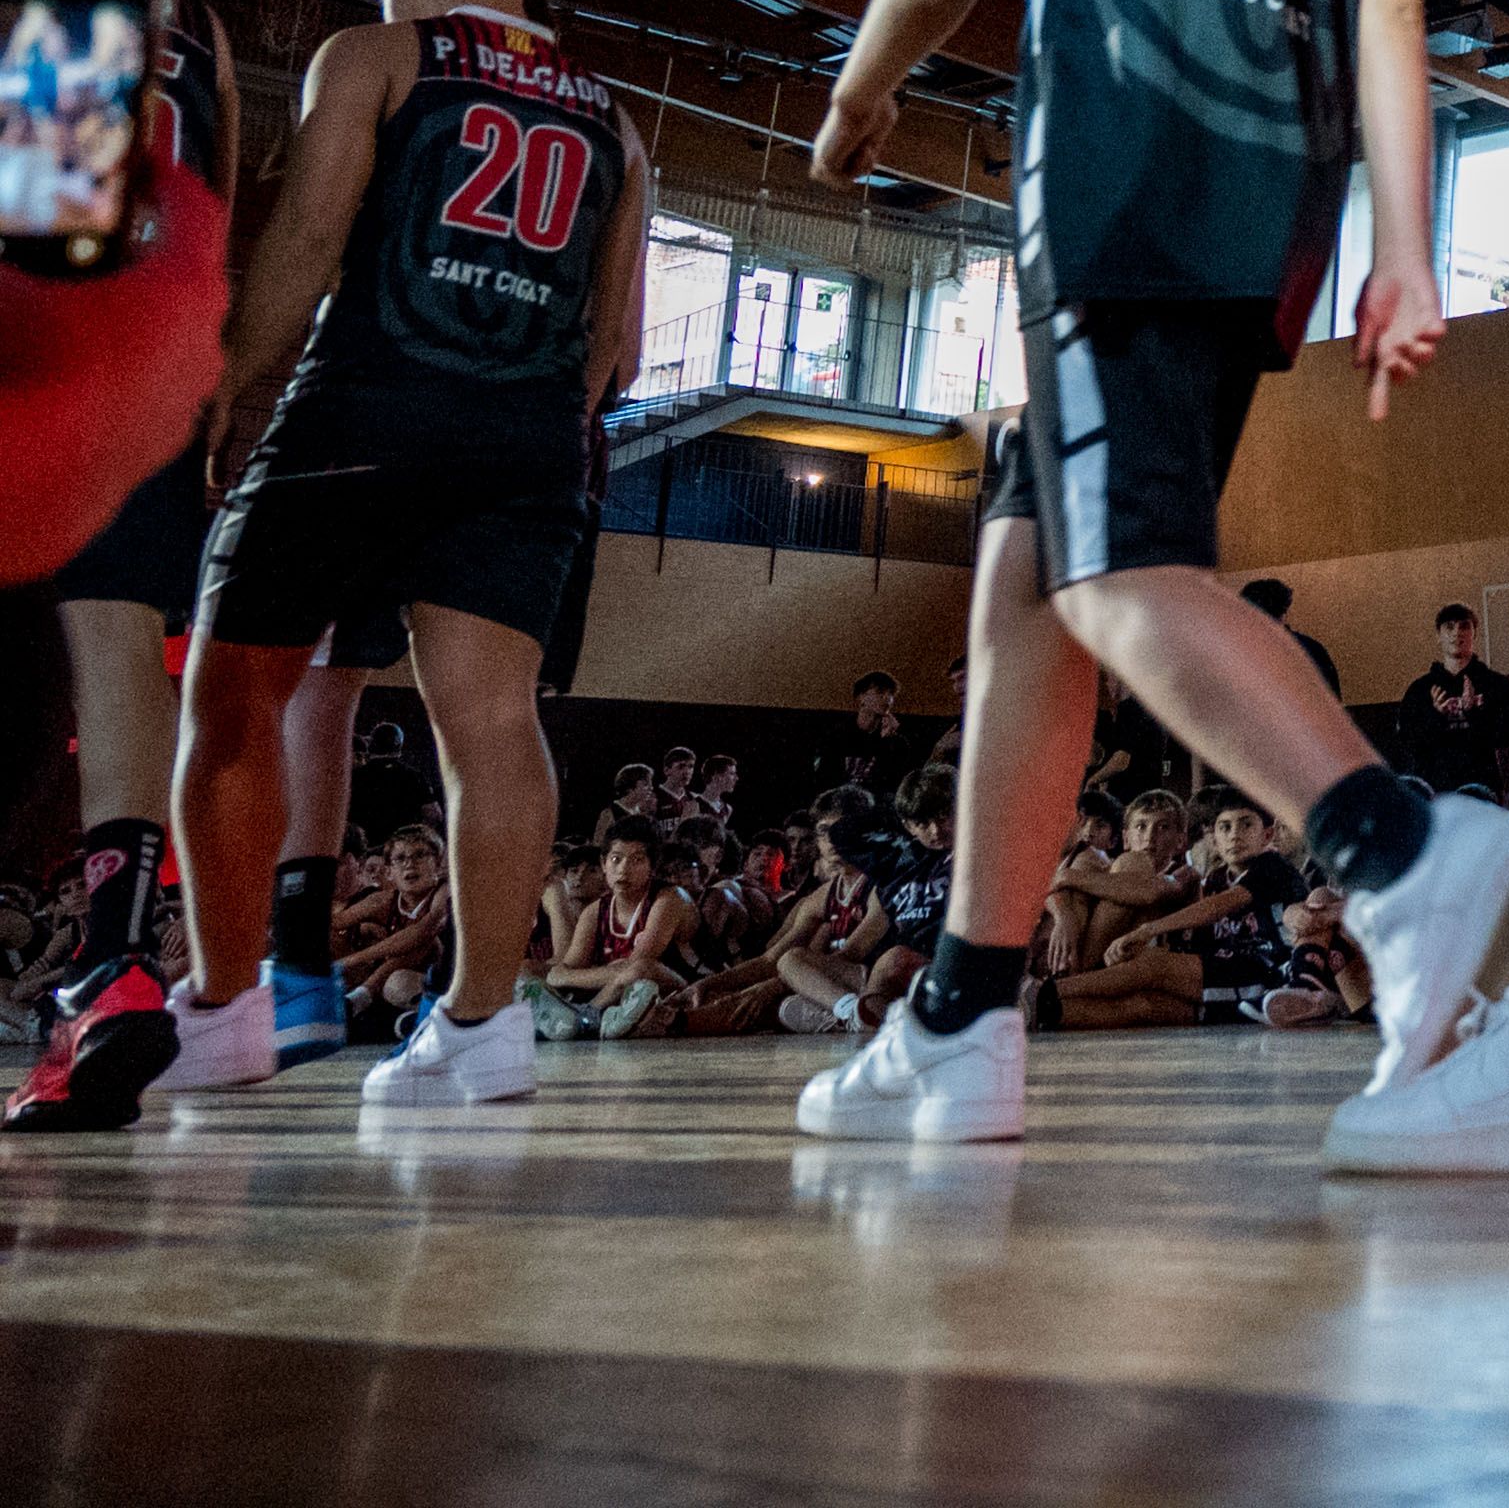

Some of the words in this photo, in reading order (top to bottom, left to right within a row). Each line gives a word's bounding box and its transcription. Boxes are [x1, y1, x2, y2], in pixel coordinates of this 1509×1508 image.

[432, 35, 468, 65] P.
[475, 43, 611, 111] DELGADO
[440, 103, 593, 252] 20
[429, 256, 493, 289] SANT
